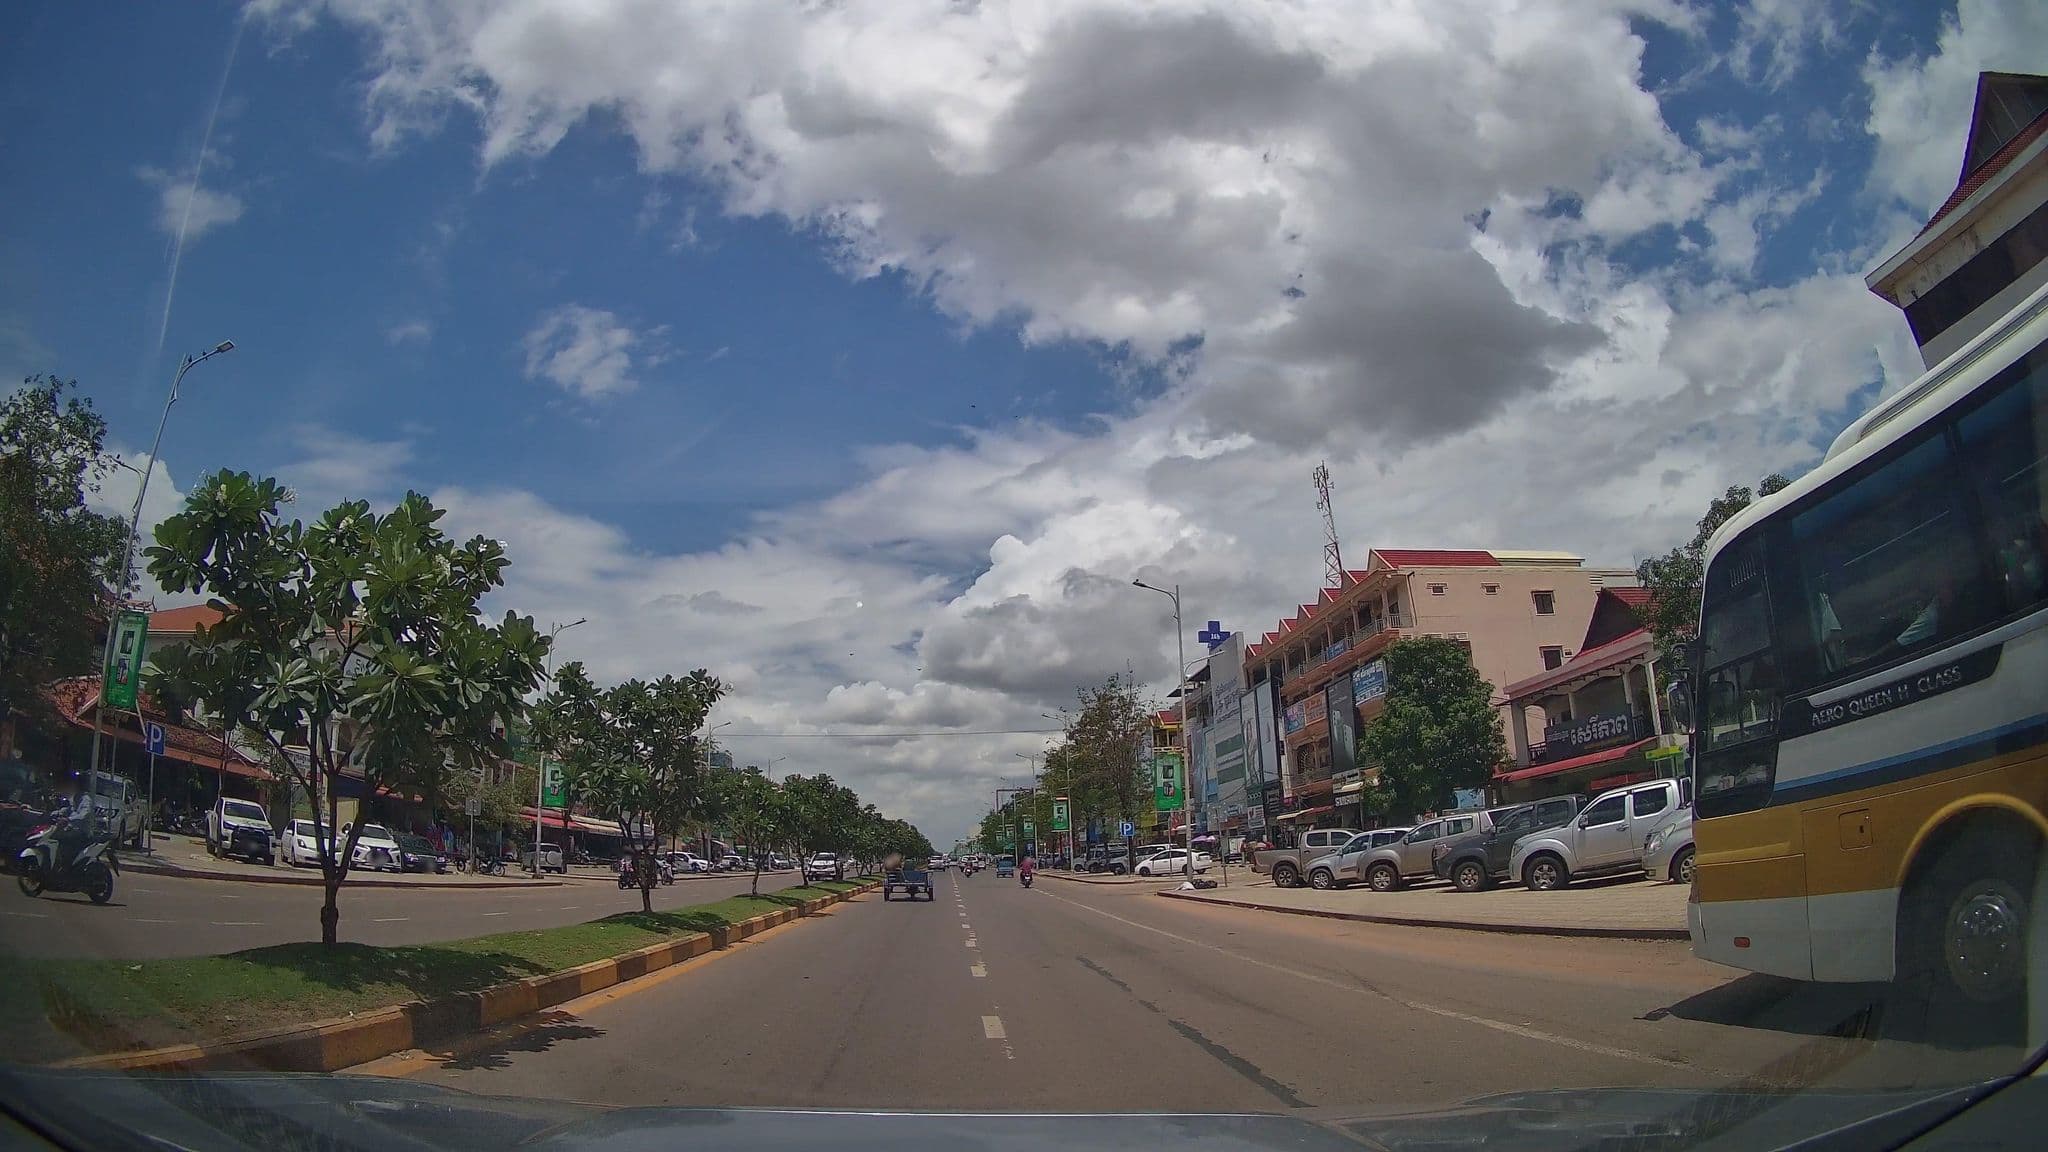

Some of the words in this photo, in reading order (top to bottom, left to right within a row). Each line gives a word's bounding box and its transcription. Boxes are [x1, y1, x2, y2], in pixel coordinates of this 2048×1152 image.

[1811, 704, 1844, 726] AERO
[1848, 689, 1893, 715] QUEEN
[1917, 665, 1962, 693] CLASS
[150, 724, 162, 751] P
[1123, 823, 1132, 835] P
